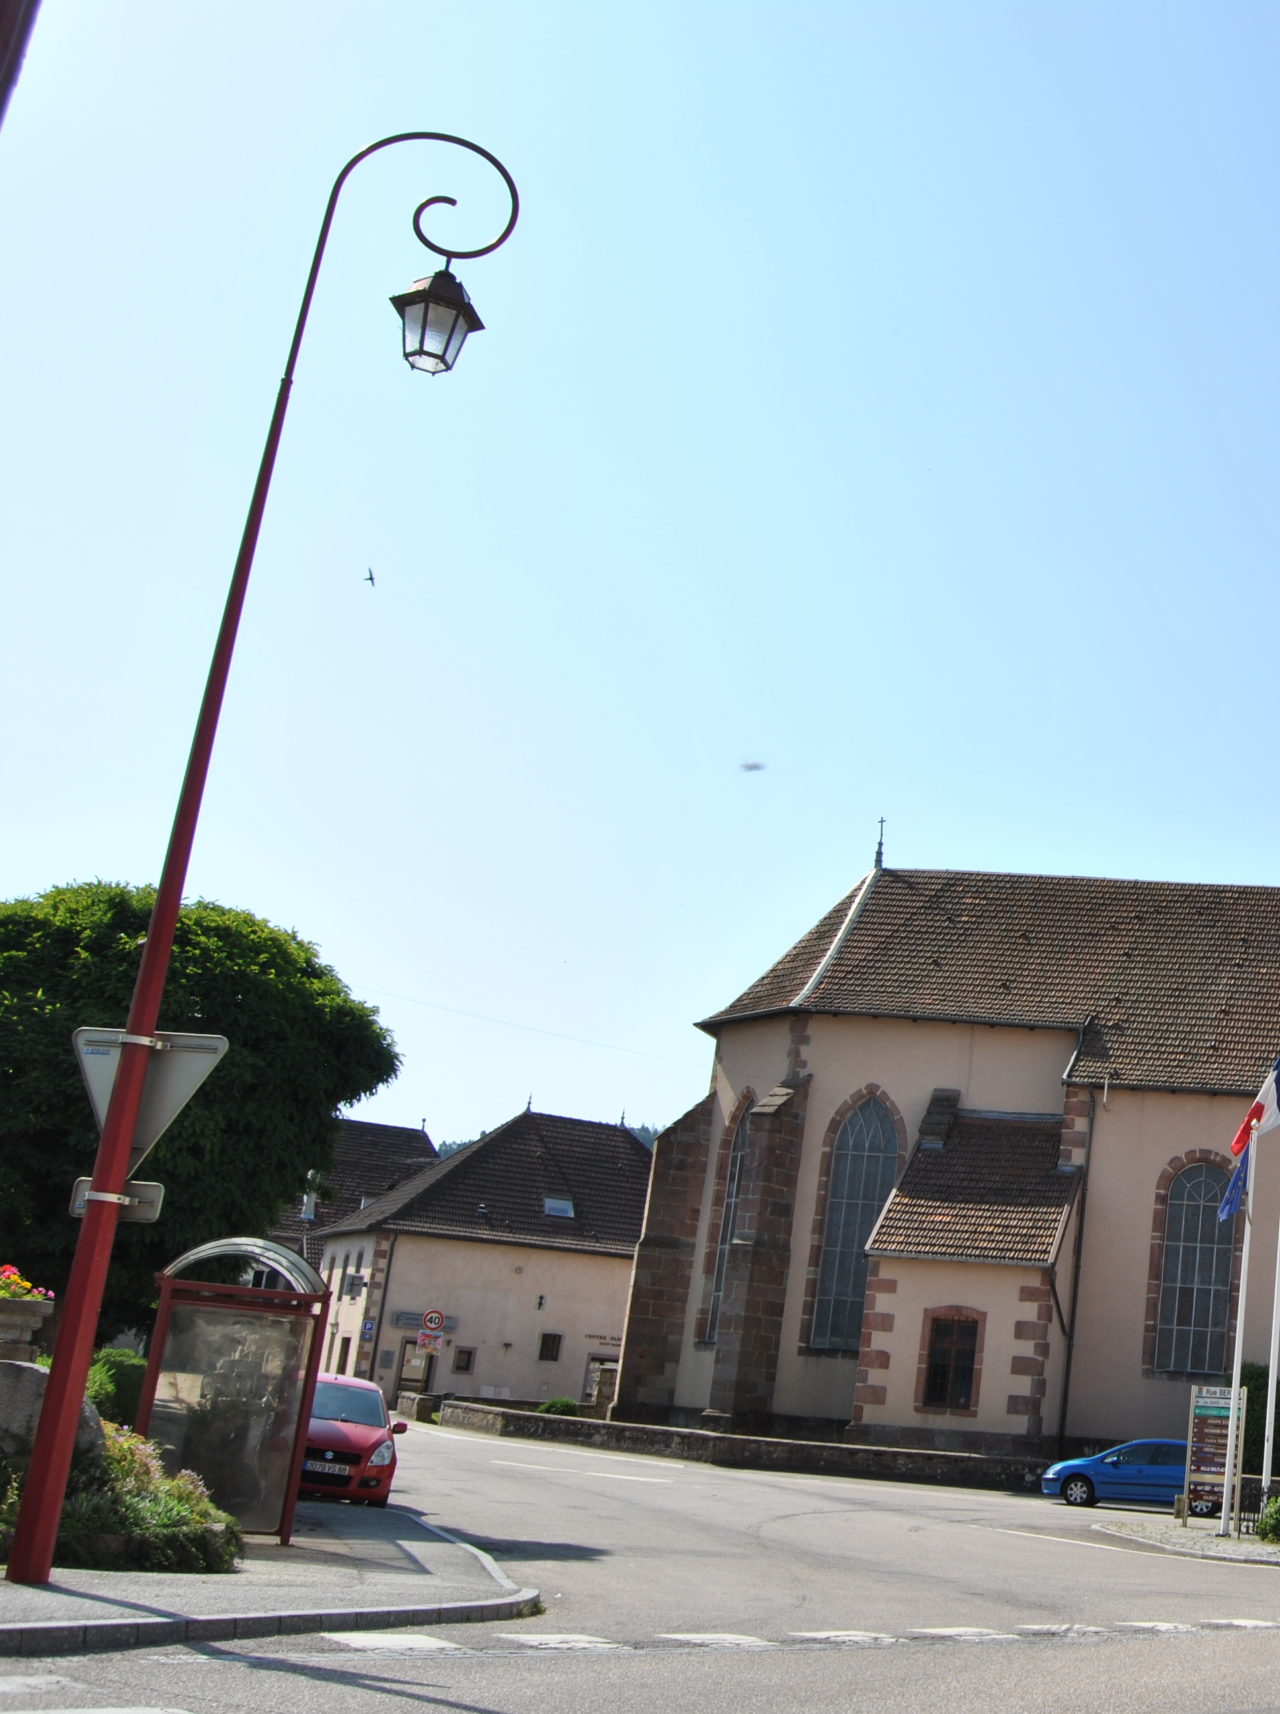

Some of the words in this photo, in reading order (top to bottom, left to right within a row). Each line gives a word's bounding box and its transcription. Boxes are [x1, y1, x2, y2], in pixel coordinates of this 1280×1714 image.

[427, 1315, 440, 1325] 40
[365, 1322, 373, 1330] P
[1205, 1388, 1218, 1396] Rue
